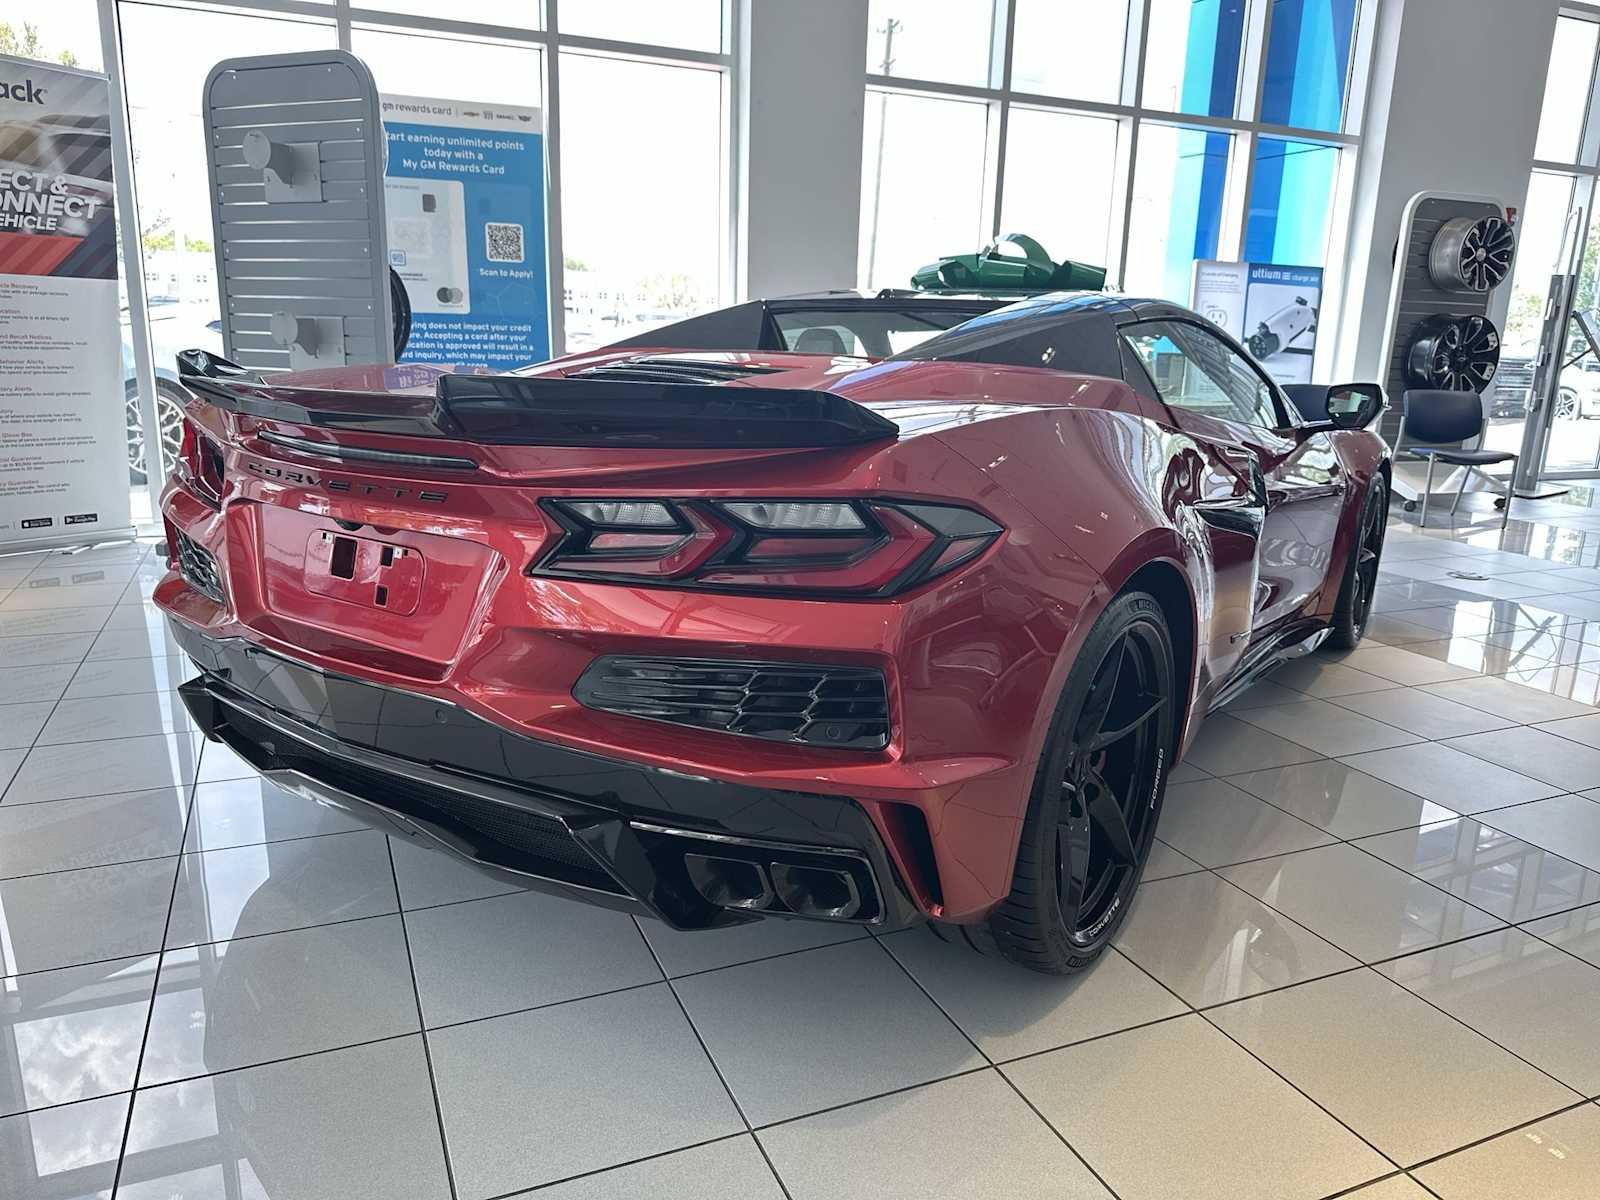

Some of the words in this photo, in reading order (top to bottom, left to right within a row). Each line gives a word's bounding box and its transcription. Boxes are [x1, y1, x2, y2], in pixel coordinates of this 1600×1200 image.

[395, 103, 431, 114] rewards
[432, 105, 452, 116] card
[385, 131, 405, 142] tart
[407, 134, 445, 146] earning
[447, 135, 493, 149] unlimited
[495, 138, 525, 151] points
[424, 147, 453, 160] today
[454, 149, 475, 160] with
[477, 153, 484, 161] a
[402, 159, 418, 171] My
[420, 159, 436, 170] GM
[438, 161, 481, 173] Rewards
[482, 163, 505, 175] Card
[50, 175, 68, 195] &
[0, 190, 97, 219] NNECT
[479, 267, 499, 278] Scan
[500, 268, 508, 278] to
[509, 268, 534, 280] Apply!
[428, 322, 448, 330] does
[448, 322, 461, 330] not
[463, 322, 490, 332] impact
[491, 324, 508, 333] your
[509, 323, 532, 332] credit
[423, 331, 463, 341] Accepting
[471, 332, 488, 340] card
[490, 332, 507, 341] after
[509, 334, 527, 342] your
[445, 342, 481, 352] approved
[482, 342, 495, 350] will
[496, 343, 518, 351] result
[414, 351, 445, 361] inquiry,
[446, 352, 469, 360] which
[470, 353, 487, 362] may
[488, 352, 514, 362] impact
[515, 354, 532, 362] your
[248, 463, 449, 504] CORVETTE
